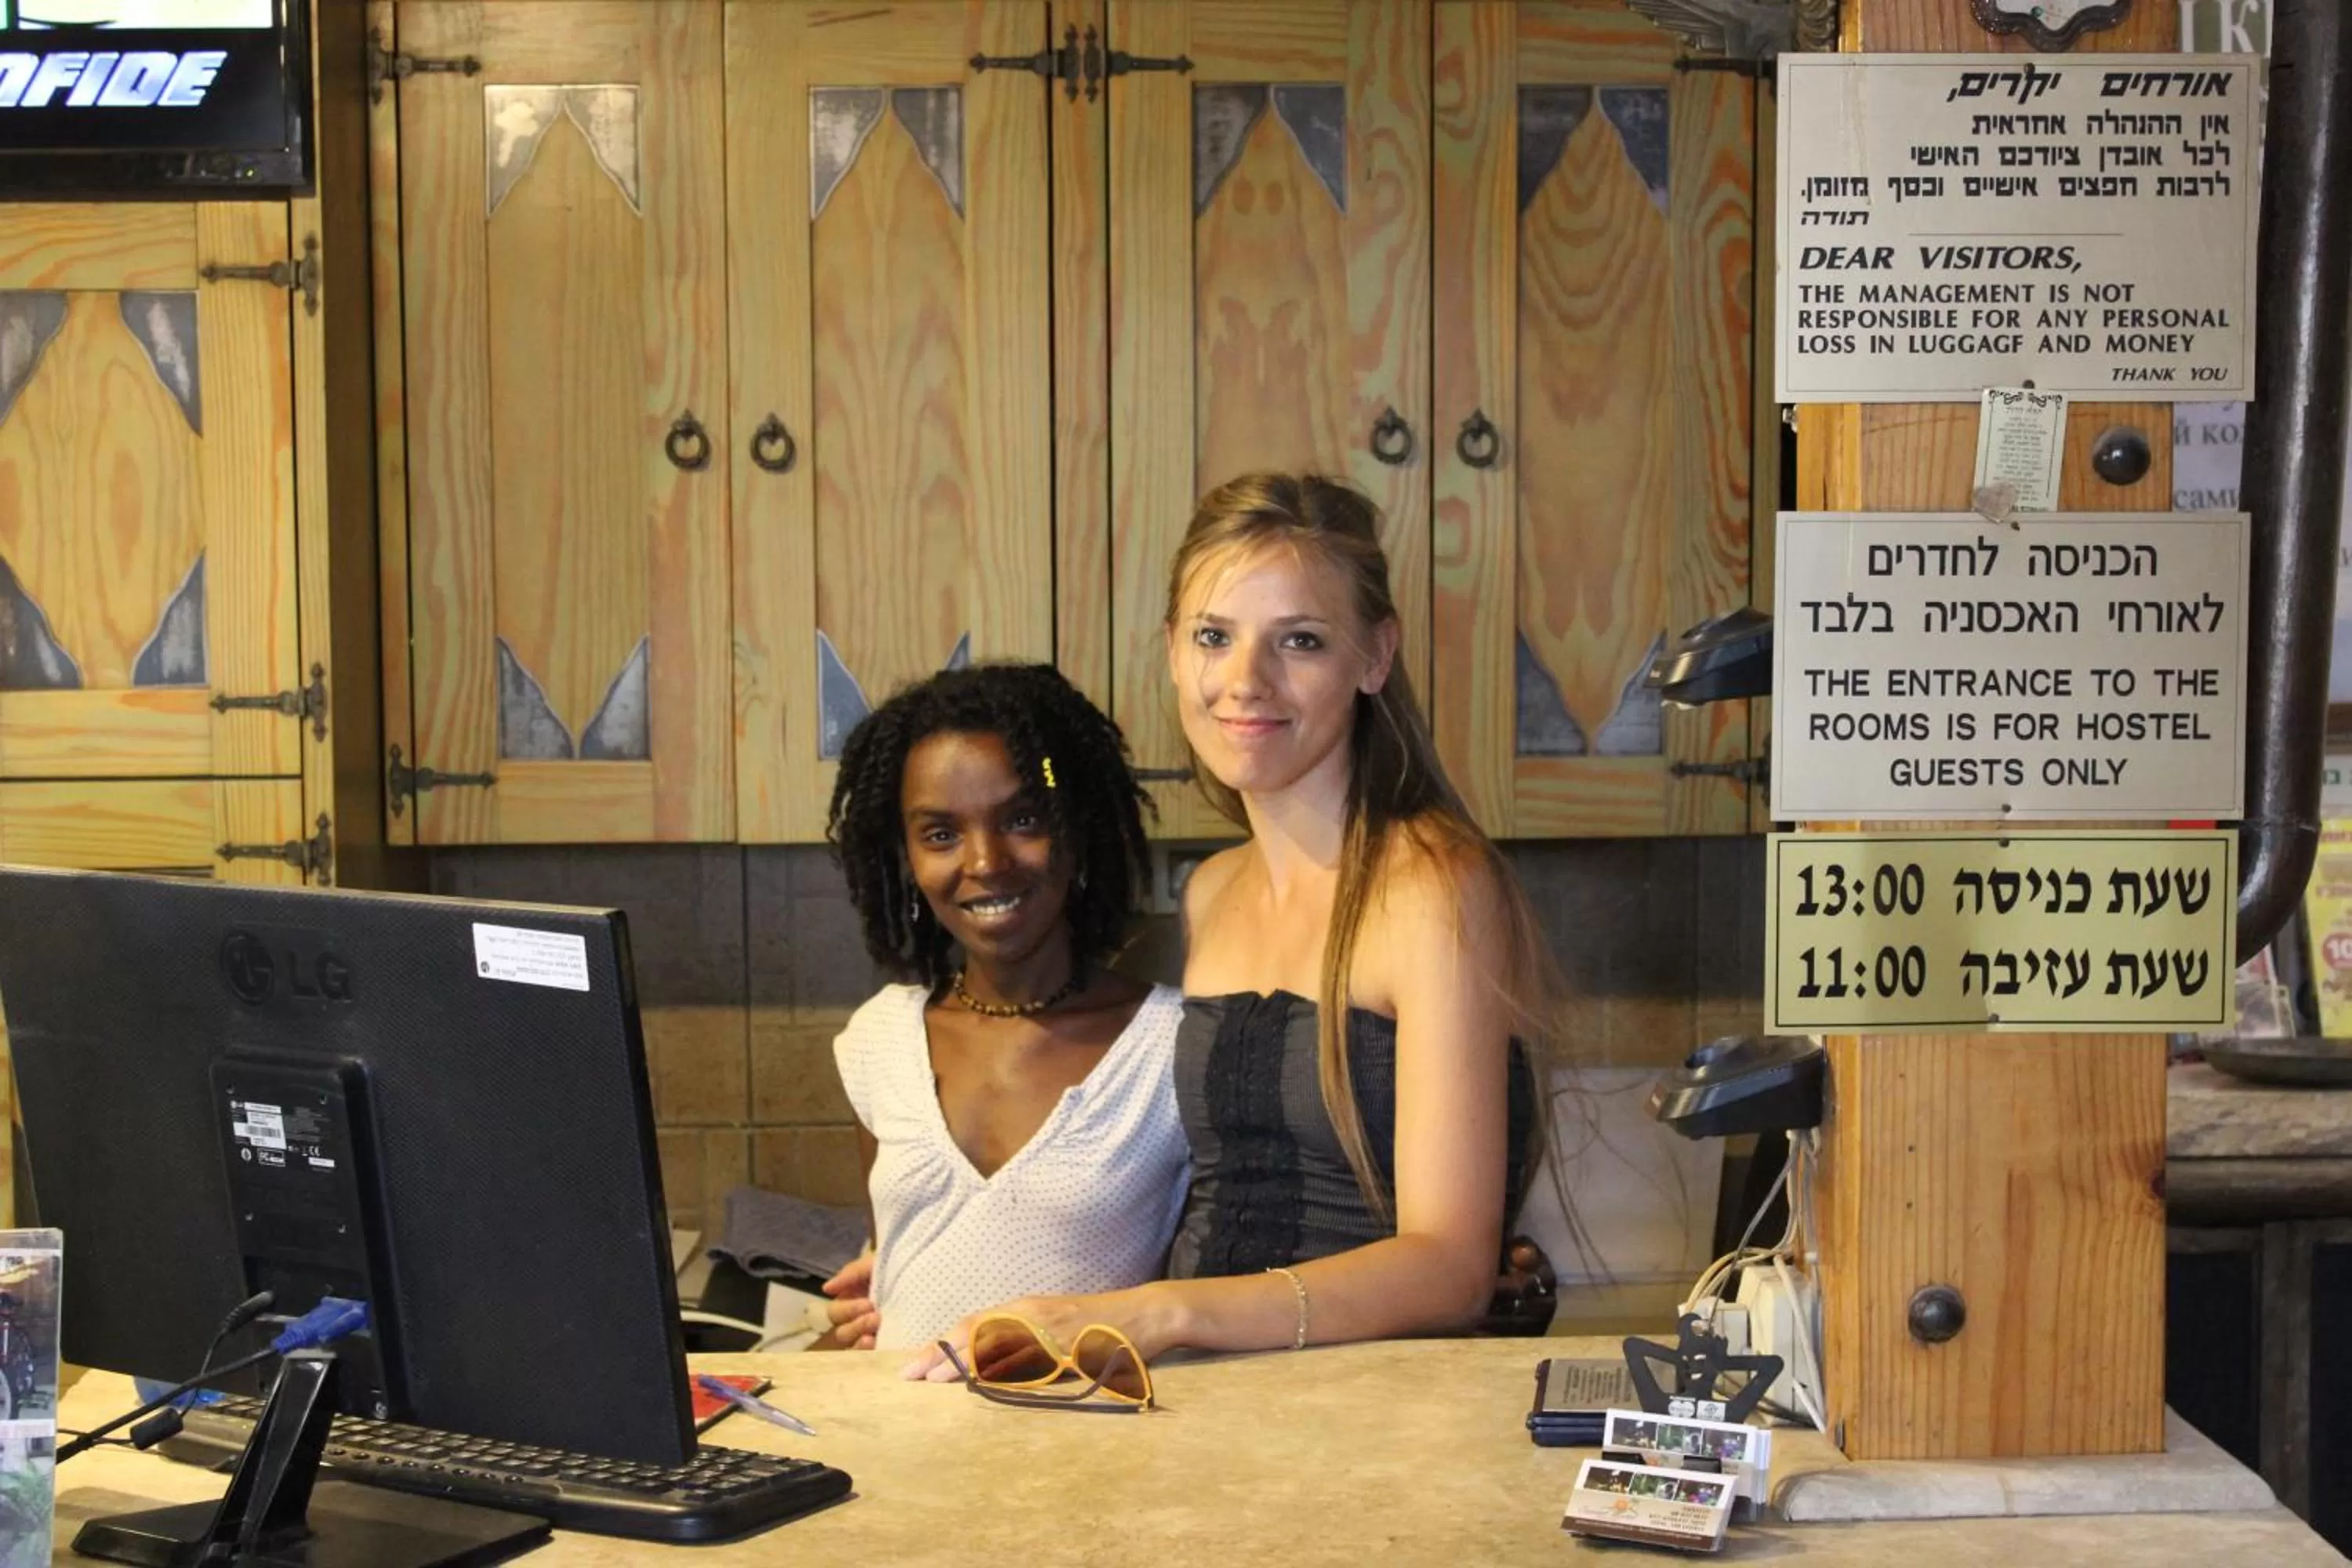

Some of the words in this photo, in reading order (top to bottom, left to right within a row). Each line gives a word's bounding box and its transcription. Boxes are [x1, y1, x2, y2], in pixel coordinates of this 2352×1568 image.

[1947, 72, 2062, 105] יקרים,
[2100, 72, 2233, 97] אורחים
[1972, 114, 2067, 135] אחראית
[2086, 109, 2183, 135] ההנהלה
[2201, 114, 2230, 141] אין
[1911, 146, 1979, 166] האישי
[1998, 146, 2081, 166] ציודכם
[2100, 146, 2163, 172] אובדן
[2183, 140, 2230, 166] לכל
[1801, 176, 1869, 203] מזומן.
[1888, 176, 1944, 203] וכסף
[1962, 176, 2038, 197] אישיים
[2058, 176, 2138, 197] חפצים
[2155, 170, 2230, 197] לרבות
[1801, 210, 1870, 226] תודה
[1799, 246, 1895, 270] DEAR
[1919, 245, 2082, 274] VISITORS,
[1799, 285, 1844, 303] THE
[1859, 284, 2034, 303] MANAGEMENT
[2049, 284, 2070, 303] IS
[2084, 283, 2135, 303] NOT
[1798, 310, 1958, 328] RESPONSIBLE
[1972, 309, 2020, 328] FOR
[2036, 309, 2088, 328] ANY
[2103, 308, 2230, 328] PERSONAL
[1798, 335, 1856, 354] LOSS
[1871, 335, 1894, 354] IN
[2038, 334, 2091, 354] AND
[2105, 333, 2194, 354] MONEY
[2112, 368, 2176, 381] THANK
[2190, 367, 2228, 381] YOU
[1868, 535, 1999, 577] לחדרים
[2028, 544, 2158, 577] הכניסה
[1800, 592, 1894, 633] בלבד
[1924, 601, 2078, 633] האכסניה
[2108, 592, 2225, 633] לאורחי
[1804, 669, 1870, 697] THE
[1888, 669, 2072, 697] ENTRANCE
[2089, 668, 2136, 697] TO
[2153, 669, 2220, 697] THE
[1809, 713, 1929, 741] ROOMS
[1947, 713, 1976, 741] IS
[1994, 713, 2060, 741] FOR
[2077, 713, 2212, 741] HOSTEL
[1890, 758, 2024, 787] GUESTS
[2042, 758, 2129, 786] ONLY
[1795, 863, 1925, 916] 13:00
[1952, 866, 2092, 915] כניסה
[2107, 866, 2211, 918] שעת
[287, 951, 353, 1003] LG
[1798, 945, 1926, 998] 11:00
[1959, 948, 2090, 1000] עזיבה
[2104, 949, 2209, 1000] שעת
